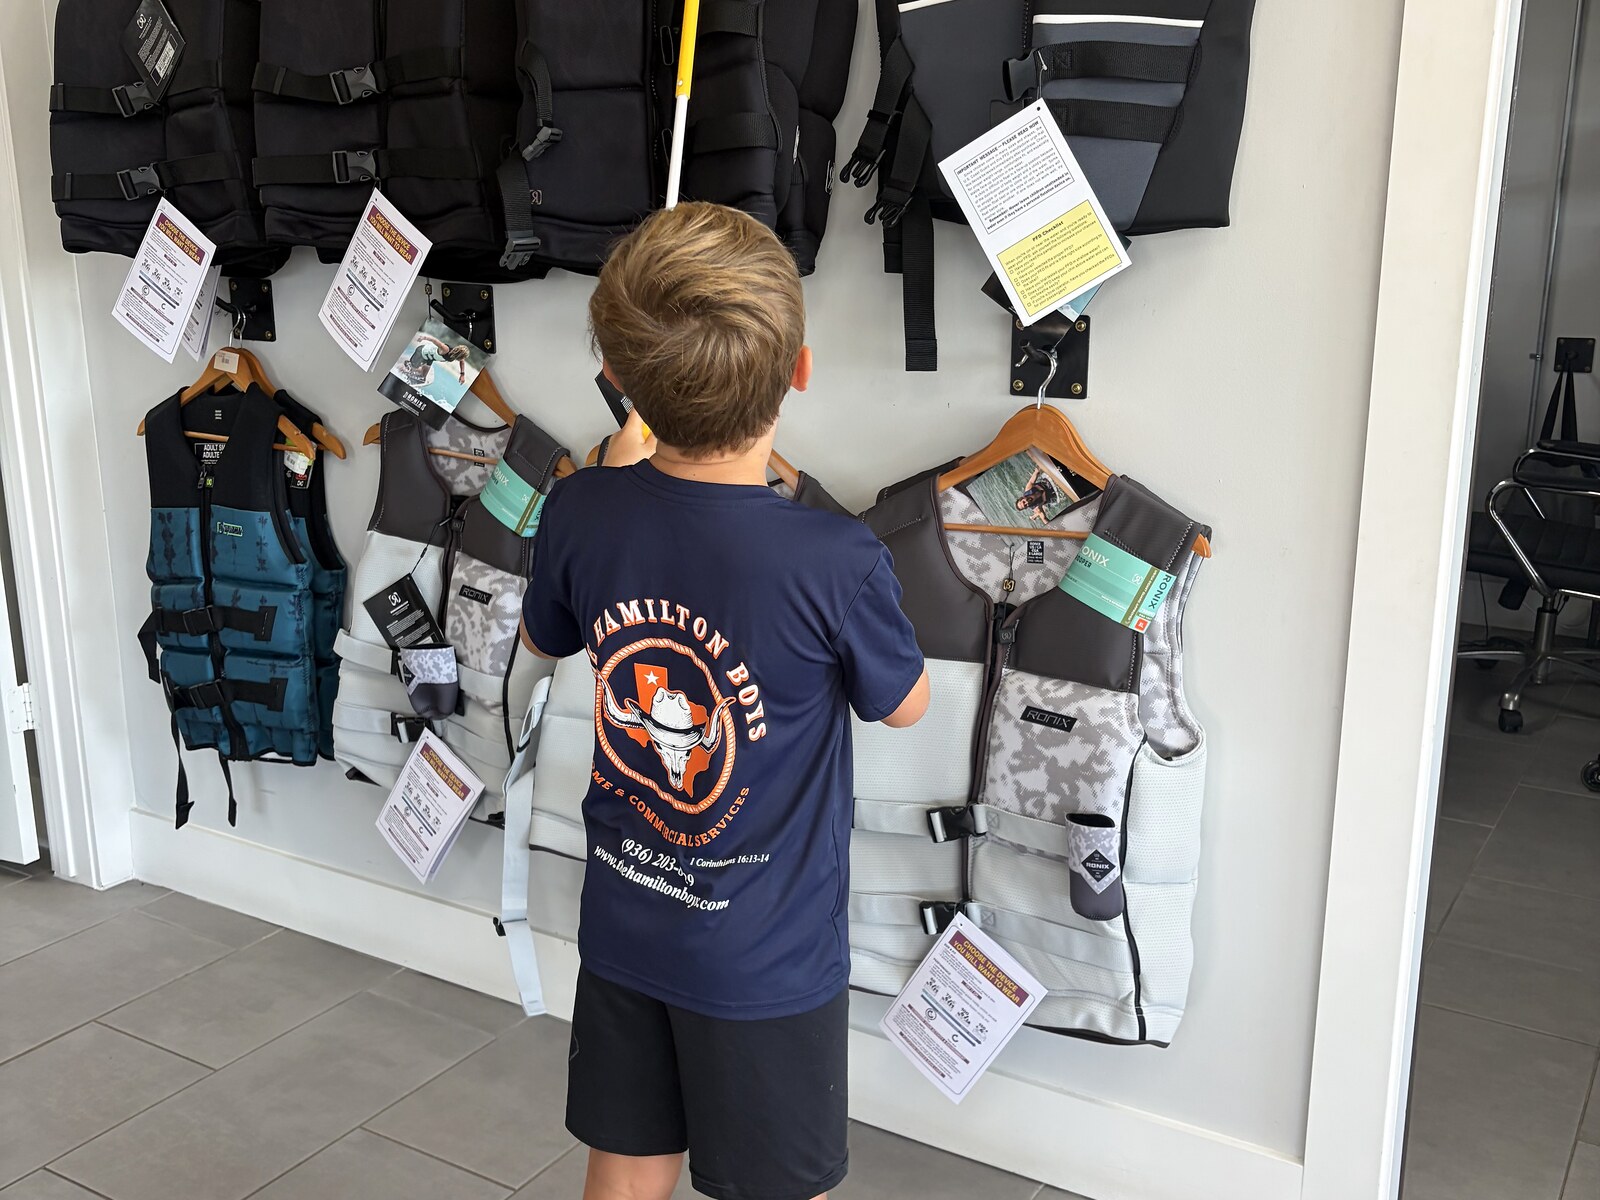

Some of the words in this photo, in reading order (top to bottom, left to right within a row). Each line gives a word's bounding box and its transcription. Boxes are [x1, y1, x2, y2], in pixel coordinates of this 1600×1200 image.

[369, 215, 378, 226] YOU
[376, 222, 385, 234] WILL
[383, 231, 395, 245] WANT
[394, 241, 400, 250] TO
[399, 246, 412, 262] WEAR
[375, 212, 391, 231] CHOOSE
[389, 227, 397, 238] THE
[395, 233, 410, 251] DEVICE
[1042, 220, 1063, 235] Checklist
[494, 468, 509, 486] ONIX
[1080, 546, 1110, 567] ONIX
[462, 588, 488, 602] RONIX
[1148, 574, 1172, 609] RONIX
[594, 599, 730, 660] HAMILTON
[726, 662, 766, 741] BOYS
[1027, 710, 1072, 728] RONIX
[614, 788, 625, 797] &
[695, 787, 749, 847] SERVICES
[622, 838, 653, 864] (936)
[737, 854, 770, 864] 16:13-14
[952, 940, 966, 954] YOU
[964, 951, 979, 966] WILL
[977, 963, 995, 981] WANT
[993, 978, 1004, 989] TO
[1001, 985, 1020, 1004] WEAR
[962, 940, 987, 964] CHOOSE
[985, 960, 998, 974] THE
[996, 970, 1019, 992] DEVICE
